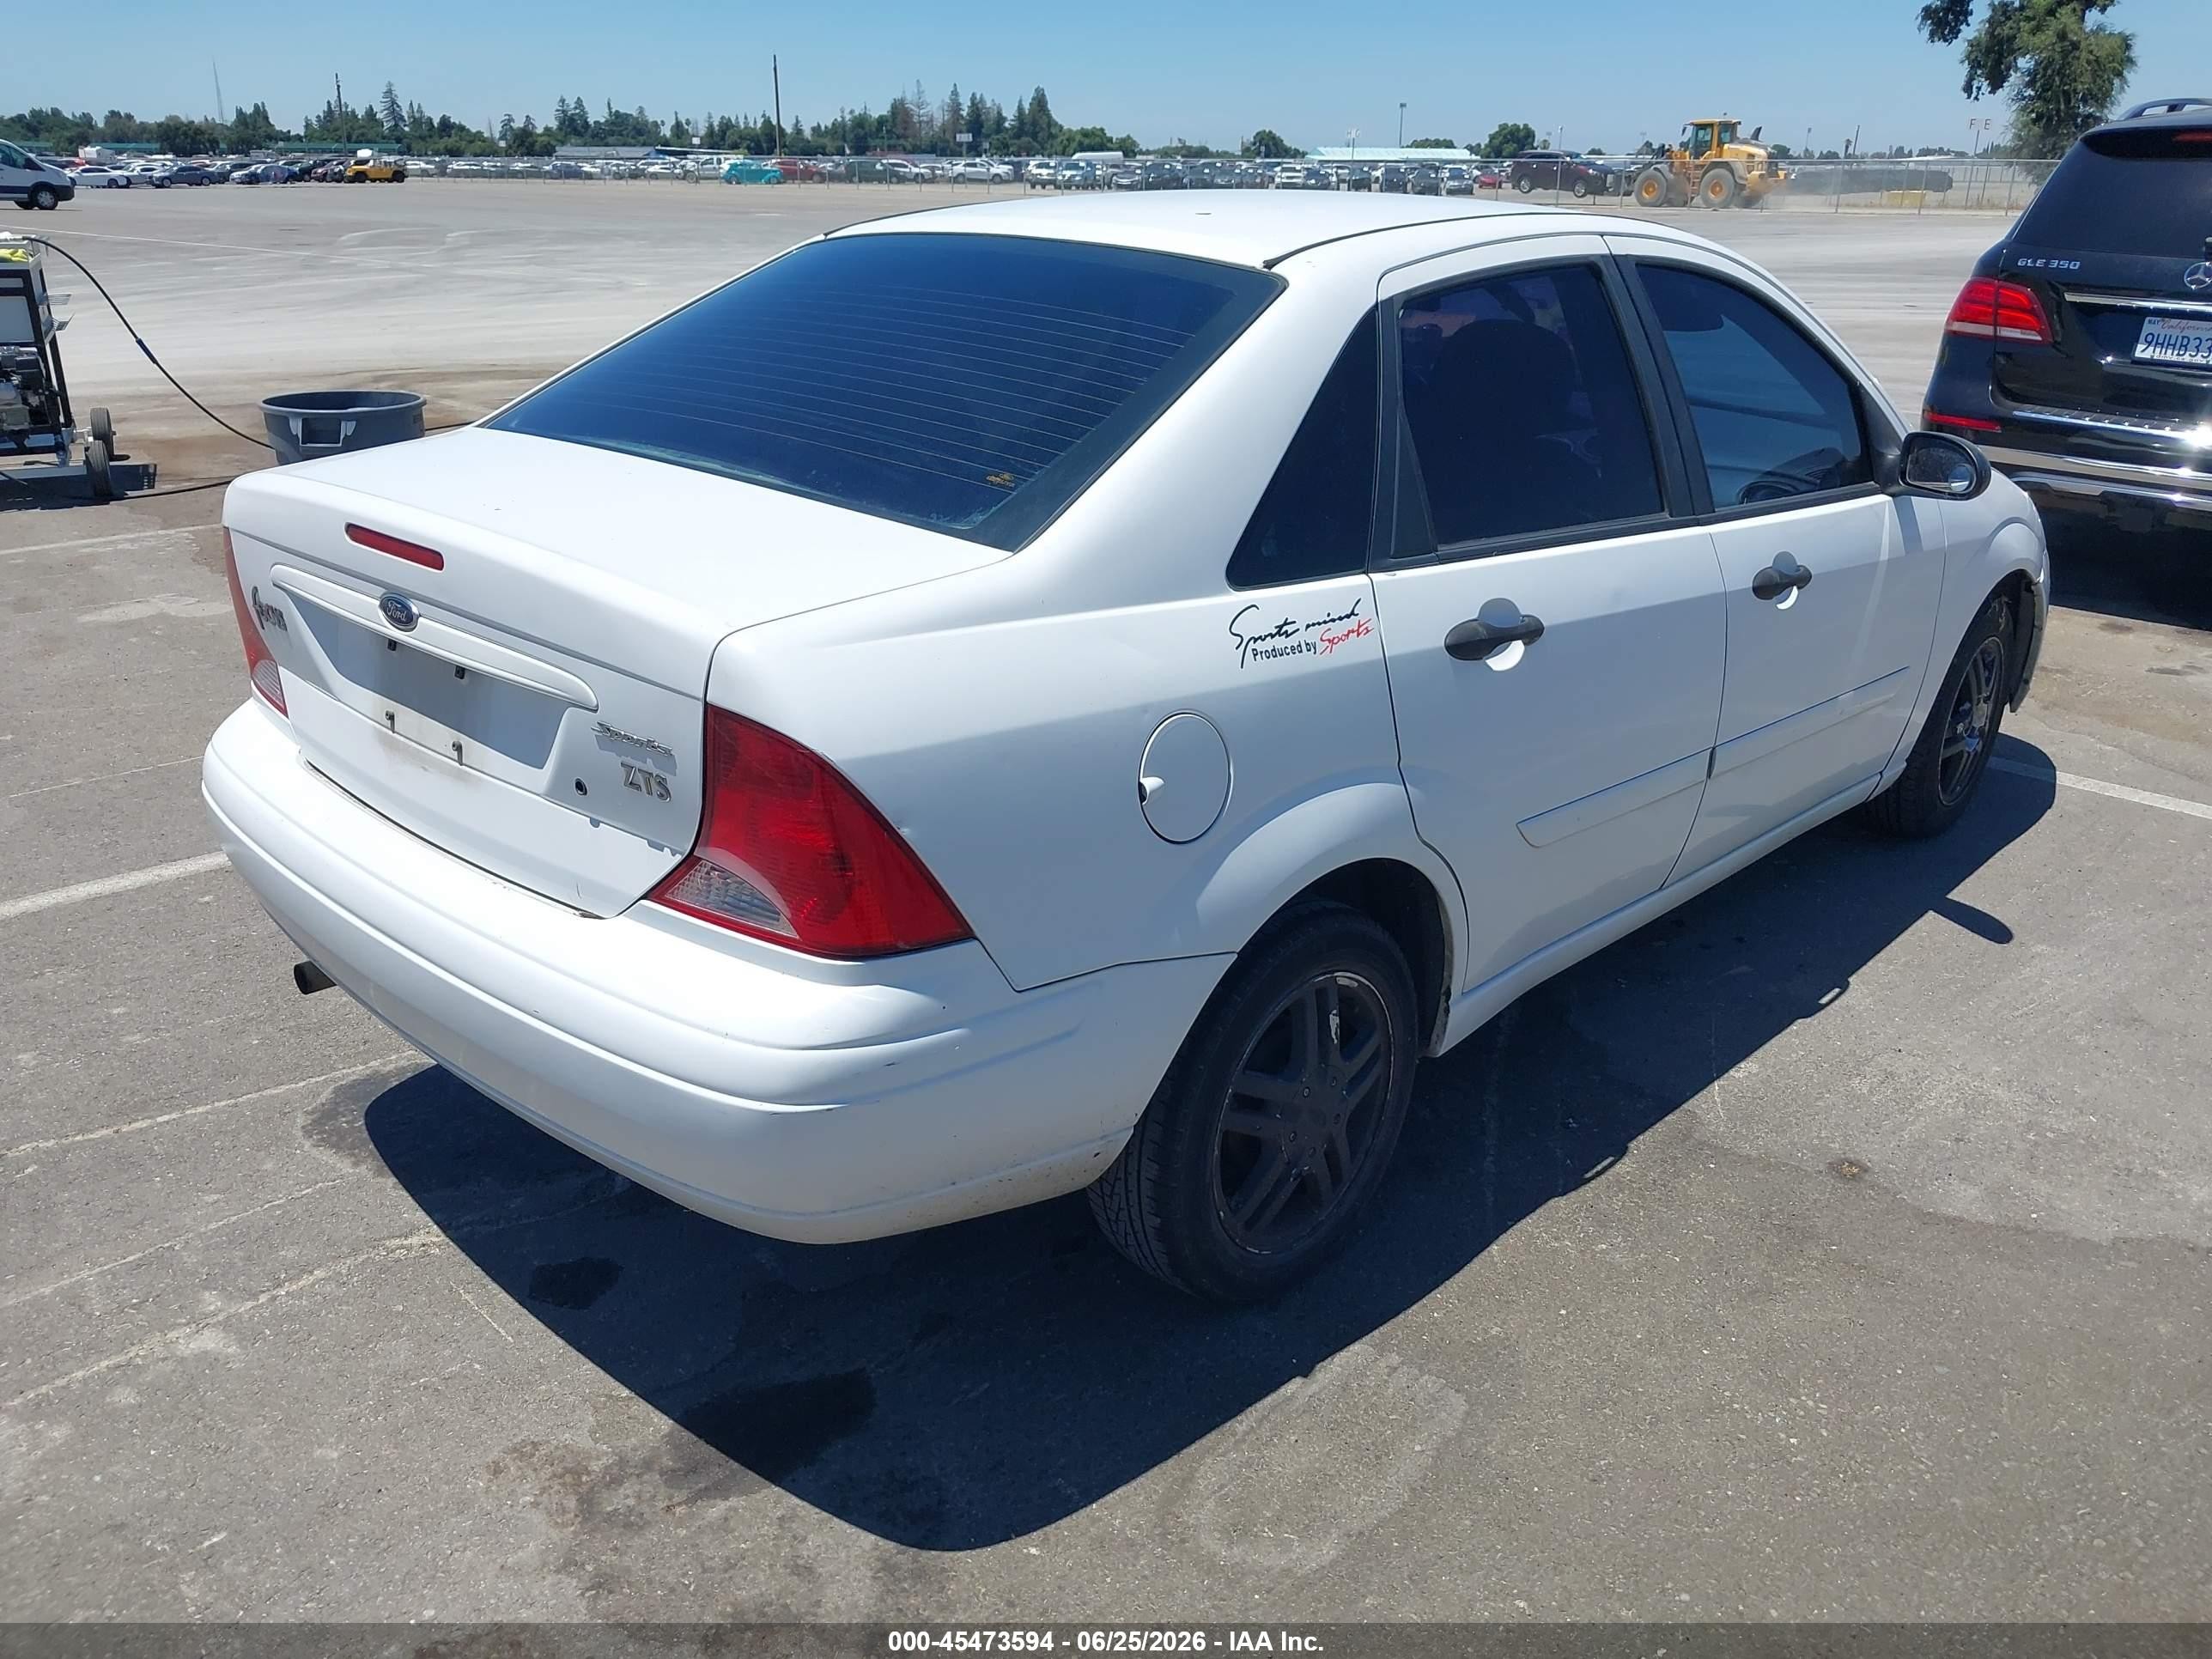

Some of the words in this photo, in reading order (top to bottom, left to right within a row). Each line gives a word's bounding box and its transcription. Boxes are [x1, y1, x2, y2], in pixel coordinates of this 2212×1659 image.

[2017, 258, 2046, 267] GLE
[2048, 259, 2081, 270] 350
[386, 599, 408, 622] Ford
[1229, 604, 1300, 669] Sports
[1251, 641, 1303, 661] Produced
[1304, 639, 1317, 655] by
[1319, 618, 1374, 655] Sports
[620, 762, 672, 802] ZTS
